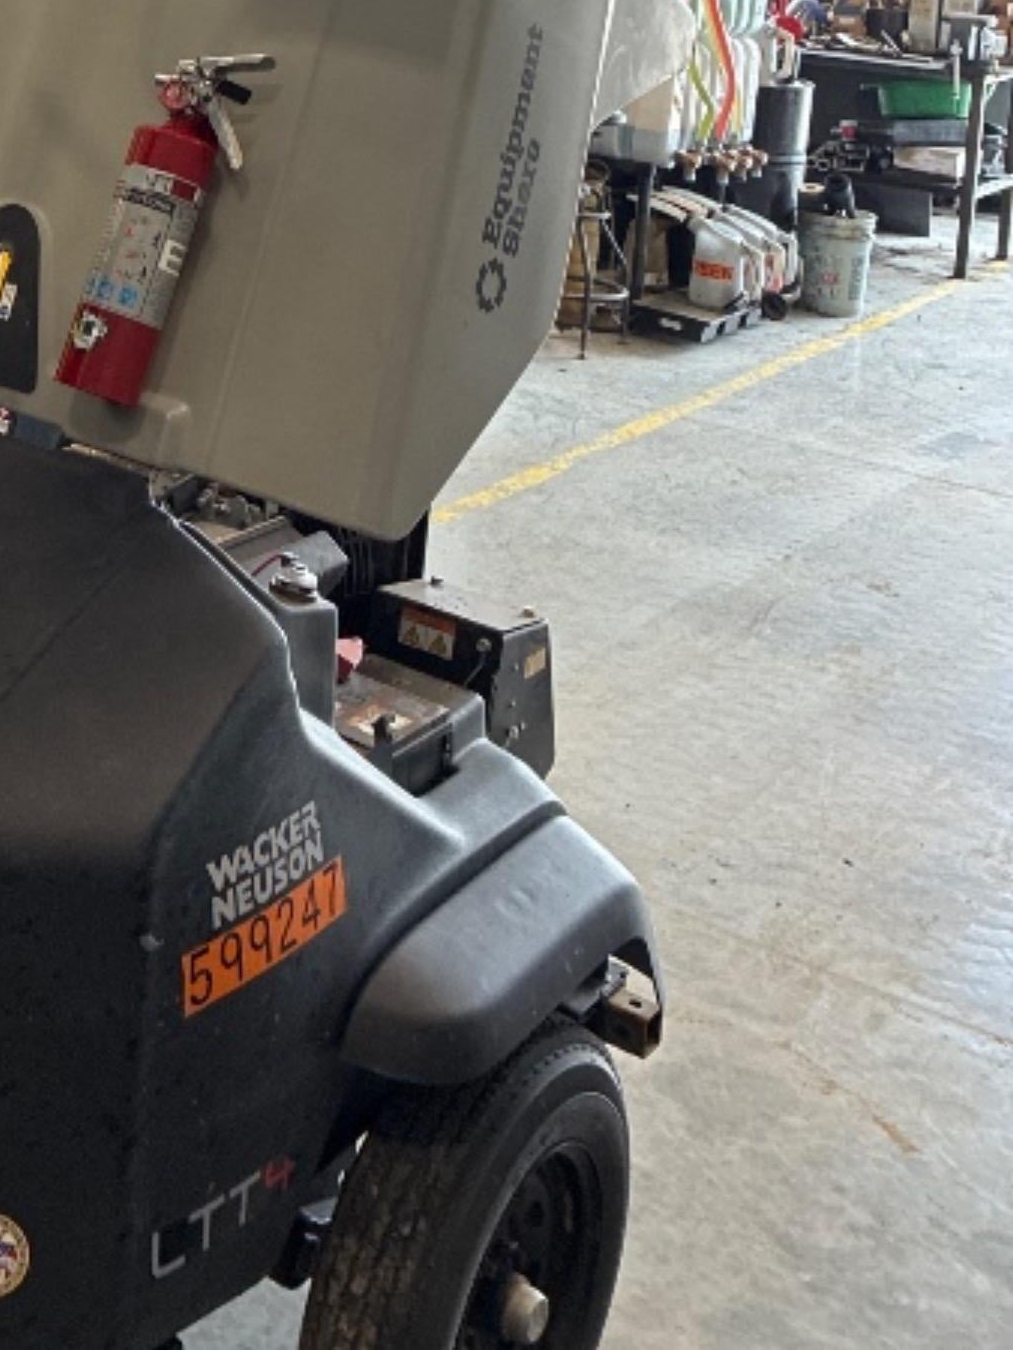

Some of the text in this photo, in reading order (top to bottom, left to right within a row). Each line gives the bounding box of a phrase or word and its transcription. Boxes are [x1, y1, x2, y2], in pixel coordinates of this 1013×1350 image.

[482, 21, 543, 249] Equipment
[205, 800, 322, 893] WACKER
[210, 830, 325, 931] NEUSON
[189, 861, 338, 1007] 599247
